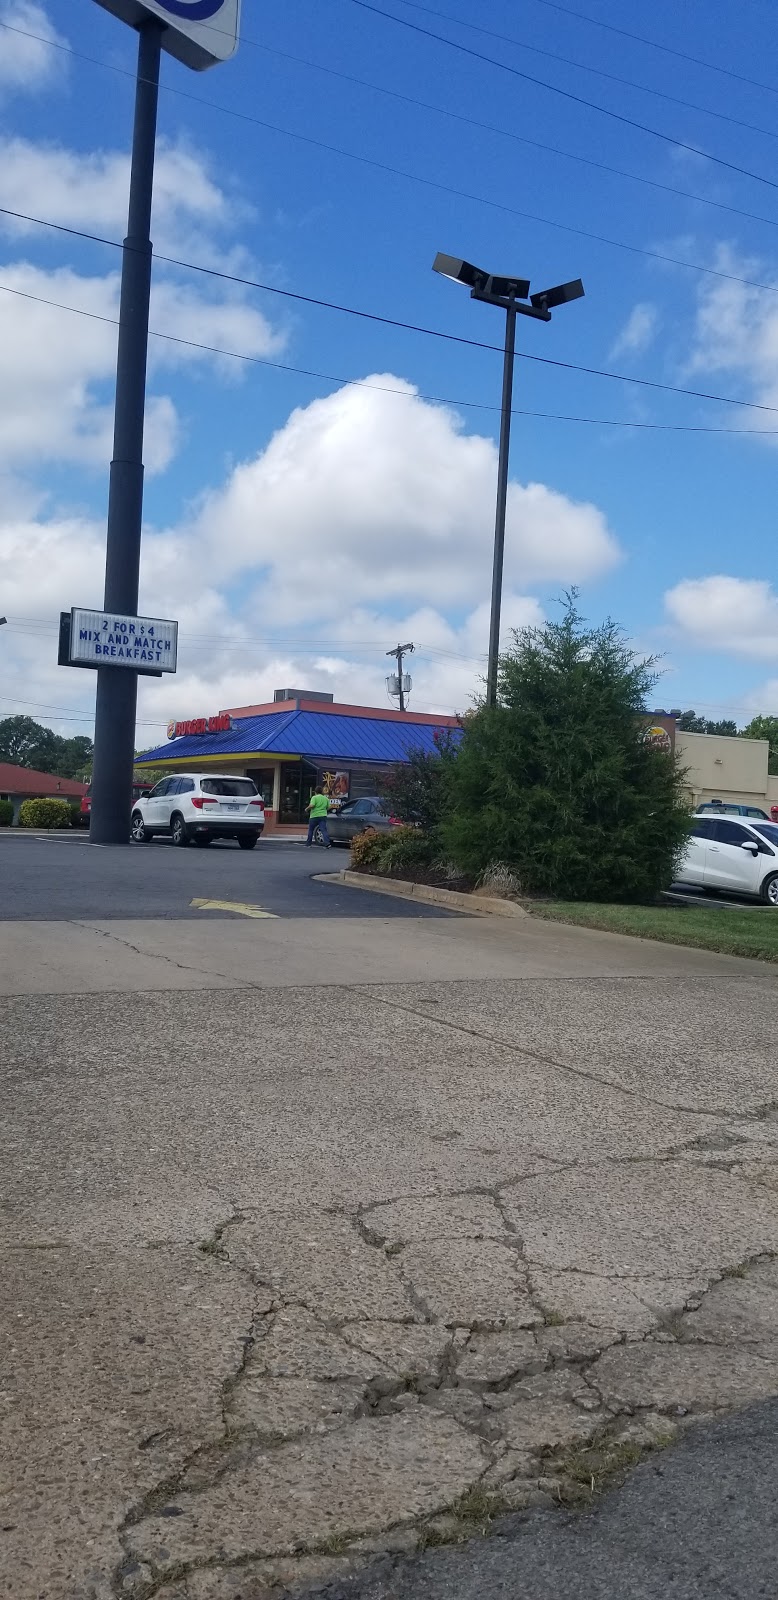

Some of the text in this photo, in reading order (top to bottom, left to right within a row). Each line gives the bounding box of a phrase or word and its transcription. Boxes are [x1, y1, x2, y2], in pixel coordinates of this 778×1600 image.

[102, 620, 108, 631] 2
[114, 622, 136, 634] FOR
[79, 630, 171, 651] MIX AND MATCH
[95, 644, 162, 661] BREAKFAST
[175, 714, 230, 736] BURGER KING
